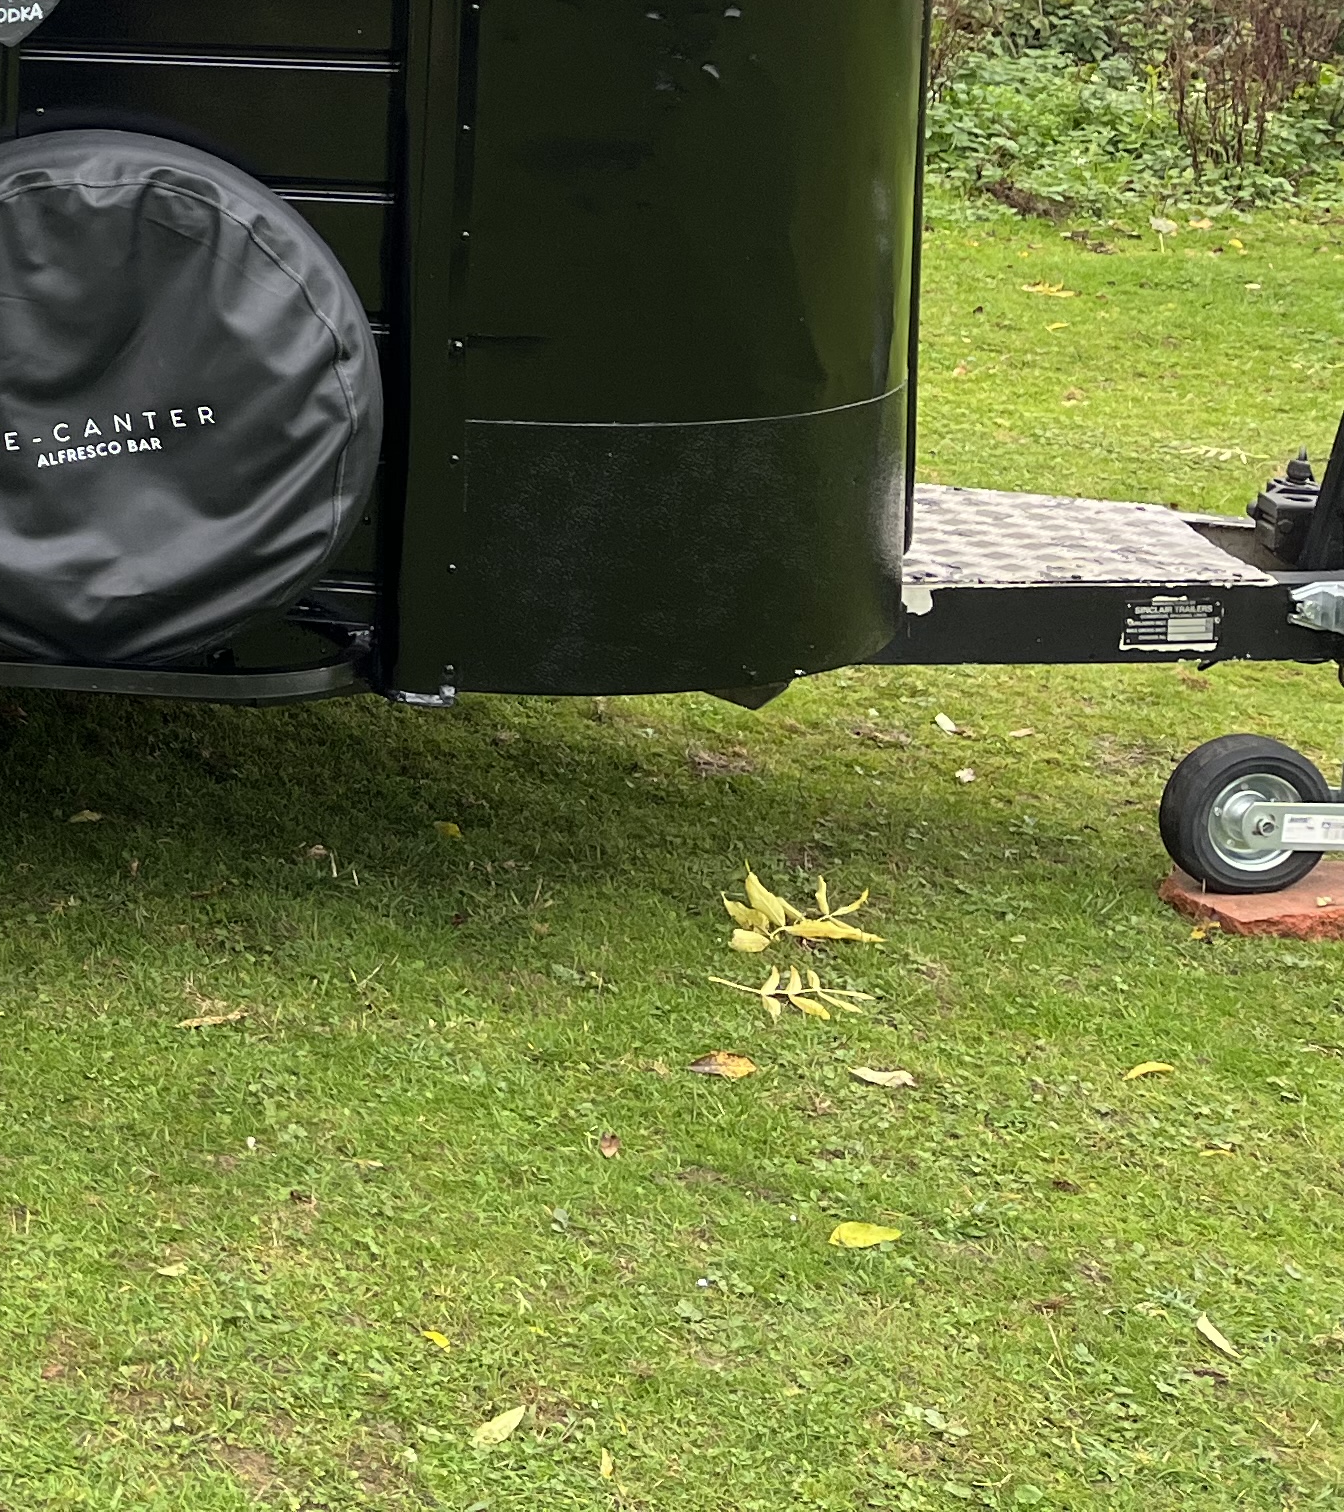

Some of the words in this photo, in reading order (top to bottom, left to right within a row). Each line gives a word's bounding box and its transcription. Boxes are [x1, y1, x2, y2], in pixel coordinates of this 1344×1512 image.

[37, 440, 121, 468] ALFRESCO
[127, 437, 162, 453] BAR
[1134, 605, 1173, 615] SINCLAIR
[1175, 604, 1213, 613] TRAILERS
